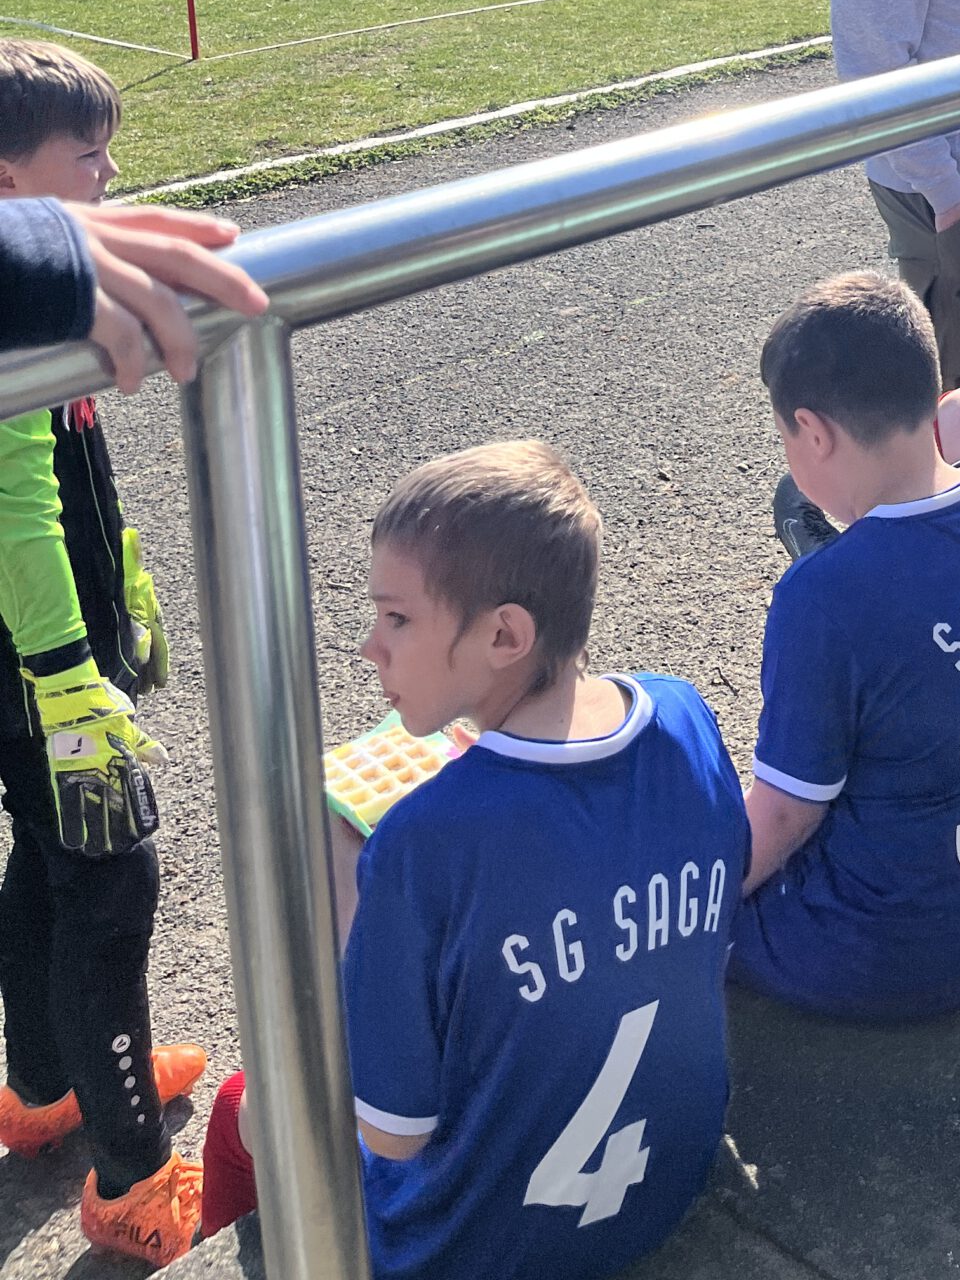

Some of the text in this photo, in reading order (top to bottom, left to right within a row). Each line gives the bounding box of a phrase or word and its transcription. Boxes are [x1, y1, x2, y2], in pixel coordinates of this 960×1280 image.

[132, 768, 157, 827] reusch
[502, 858, 727, 1004] SG SAGA
[522, 998, 661, 1229] 4
[113, 1221, 162, 1249] FILA
